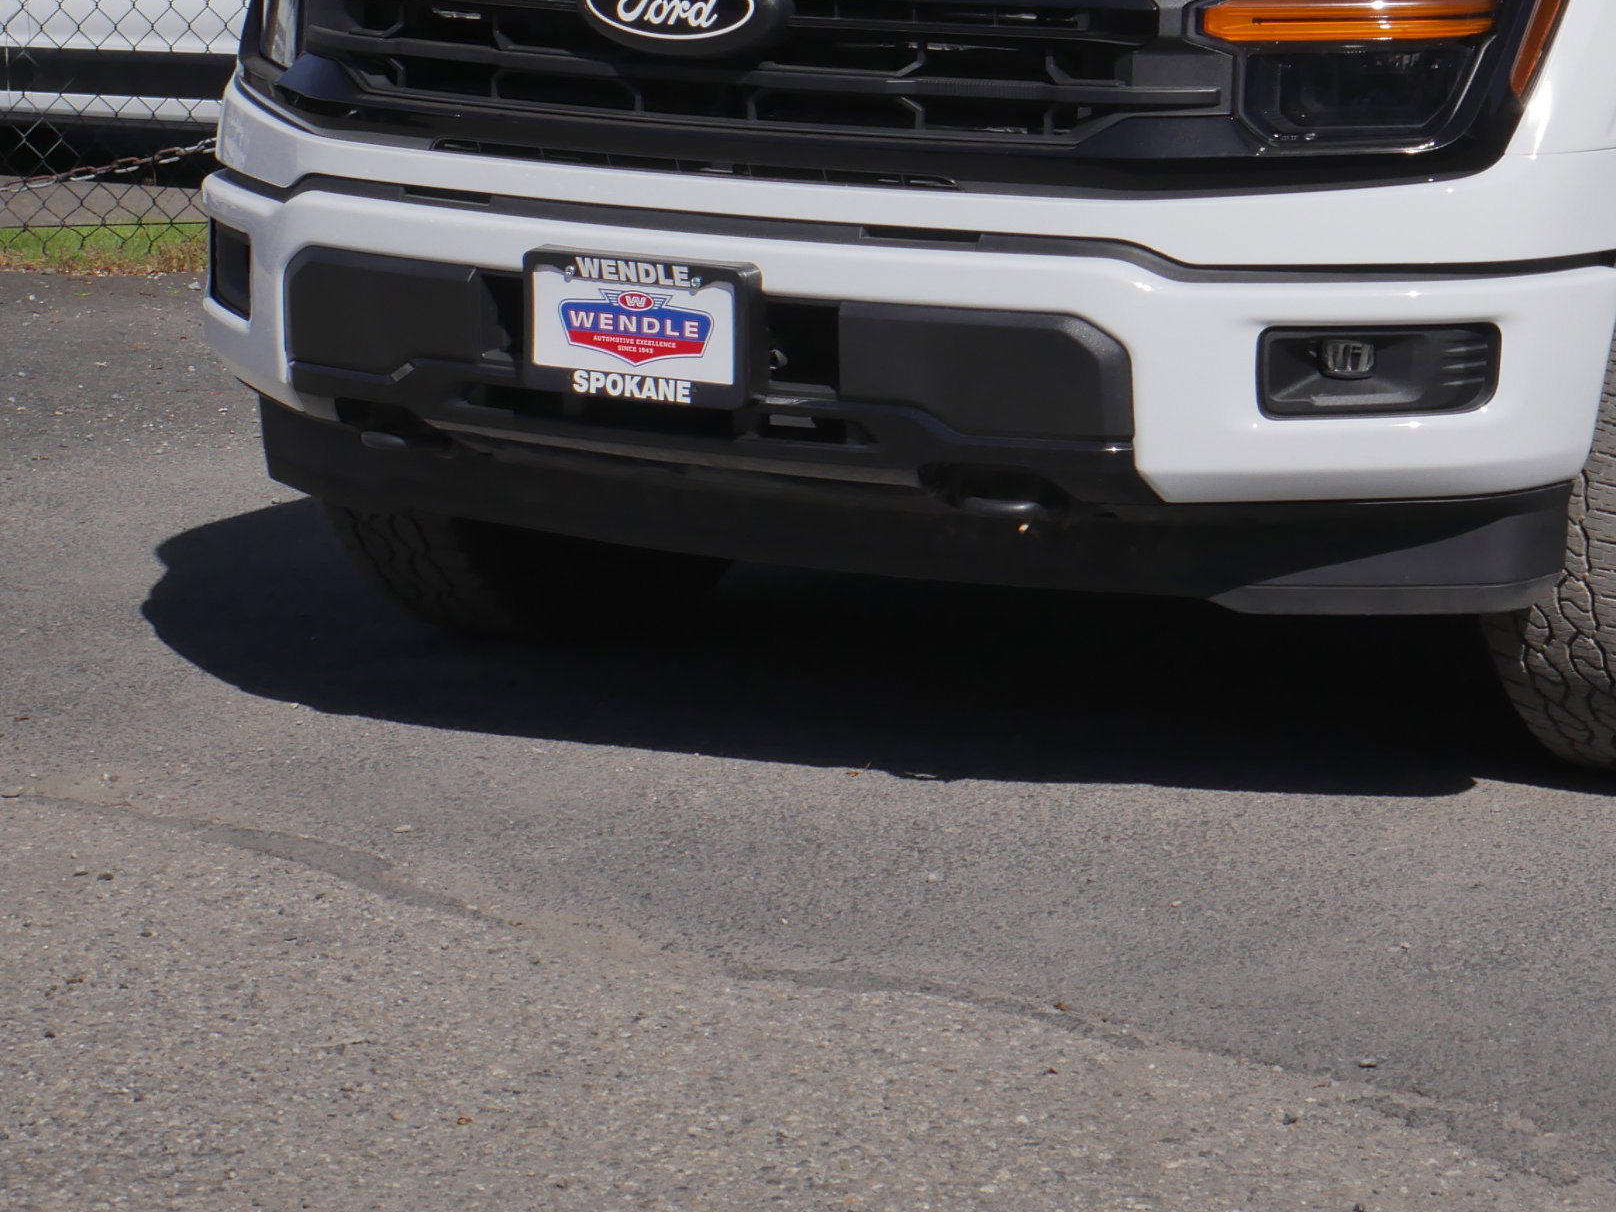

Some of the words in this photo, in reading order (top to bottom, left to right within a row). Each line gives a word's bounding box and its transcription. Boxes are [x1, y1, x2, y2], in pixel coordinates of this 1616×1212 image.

[575, 256, 692, 288] WENDLE
[568, 310, 700, 339] WENDLE
[592, 335, 635, 345] AUTOMOTIVE
[635, 339, 677, 349] EXCELLENCE
[617, 345, 637, 353] SINCE
[572, 369, 692, 404] SPOKANE
